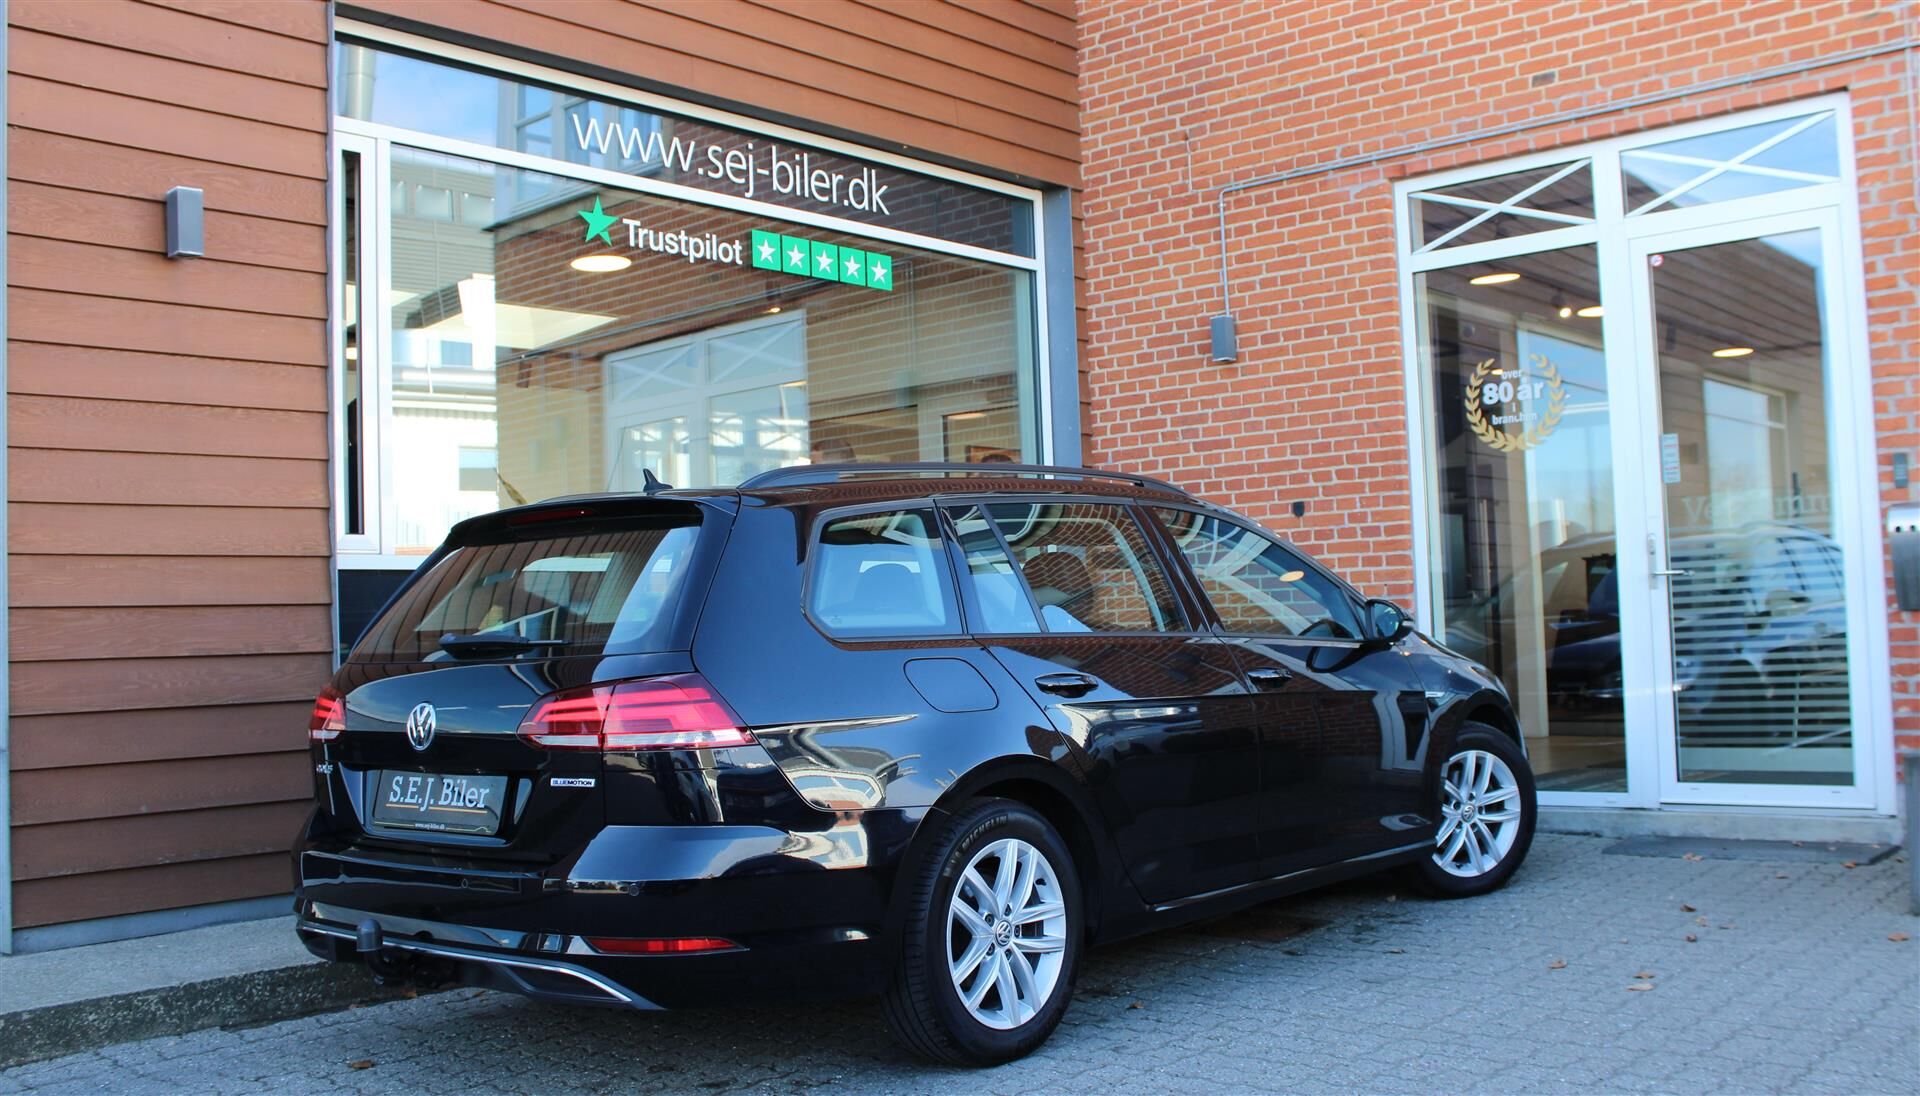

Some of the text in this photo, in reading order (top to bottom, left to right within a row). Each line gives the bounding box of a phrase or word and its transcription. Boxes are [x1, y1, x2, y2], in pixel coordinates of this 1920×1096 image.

[572, 113, 890, 215] www.sej-biler.dk
[622, 218, 743, 265] Trustpilot
[1483, 381, 1514, 405] 80
[389, 775, 490, 811] S.E.J. Biler
[961, 815, 1008, 850] MICHELIN
